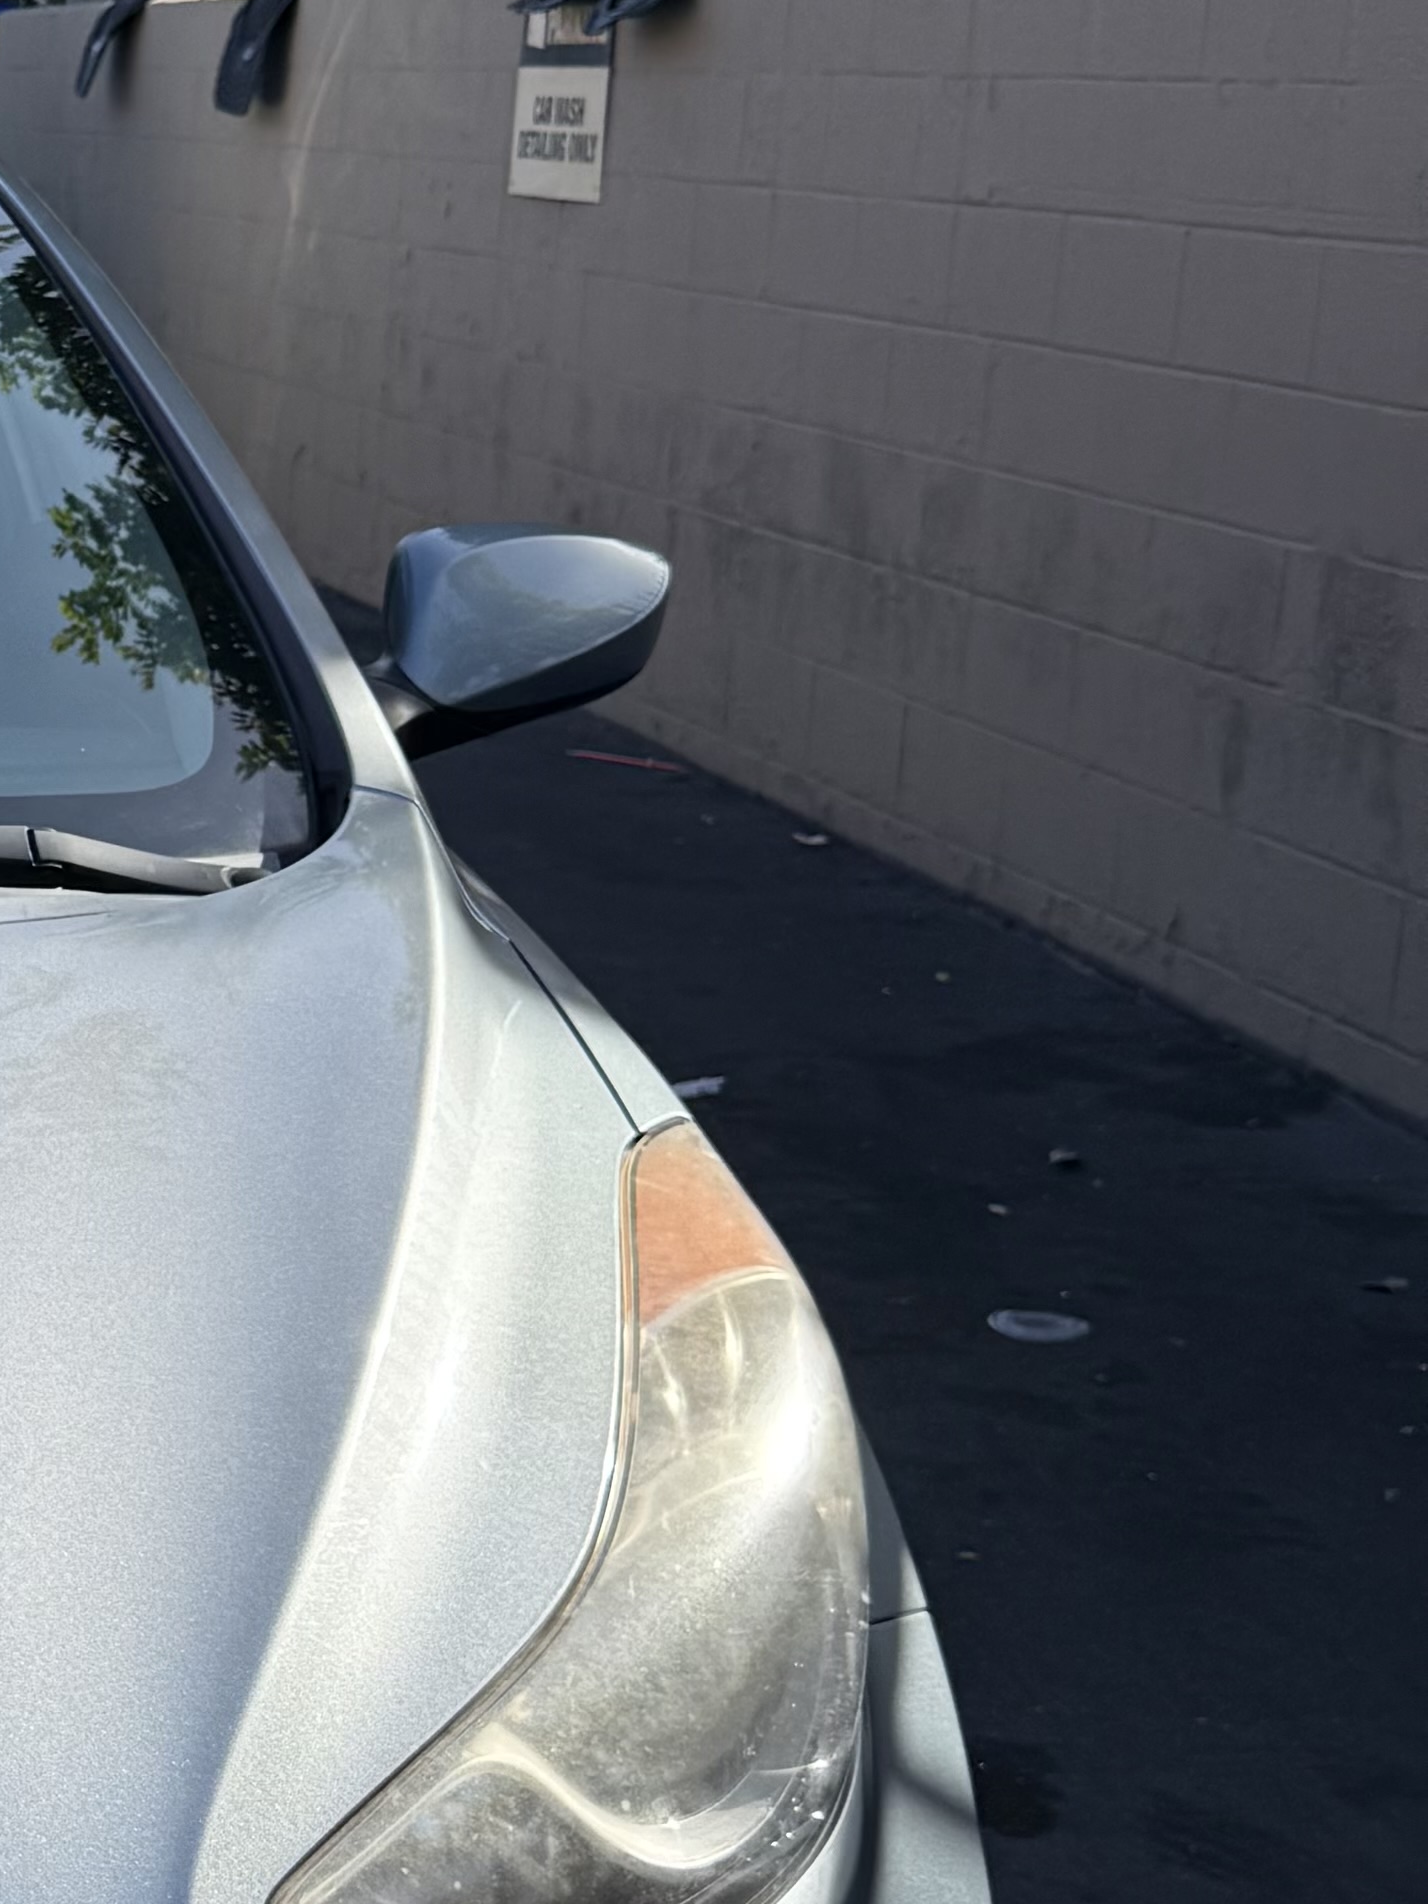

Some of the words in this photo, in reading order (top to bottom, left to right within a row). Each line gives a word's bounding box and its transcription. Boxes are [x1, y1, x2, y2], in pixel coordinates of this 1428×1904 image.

[532, 96, 553, 125] CAR
[555, 97, 586, 126] WASH
[568, 133, 597, 163] ONLY
